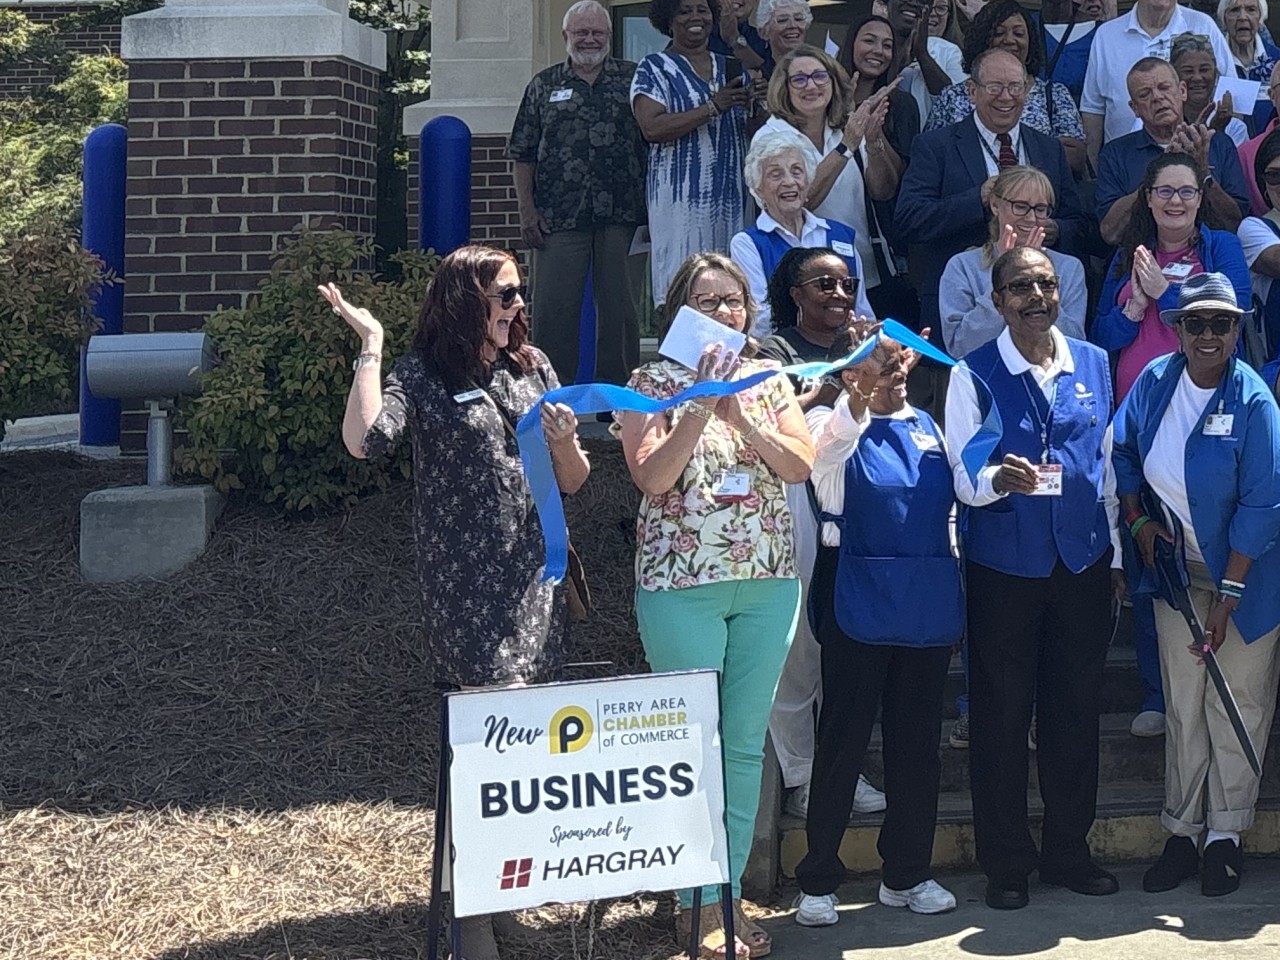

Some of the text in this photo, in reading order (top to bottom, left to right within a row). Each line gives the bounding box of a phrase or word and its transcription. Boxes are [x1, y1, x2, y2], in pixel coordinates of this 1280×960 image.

[603, 697, 687, 716] PERRY AREA
[603, 711, 688, 732] CHAMBER
[484, 714, 544, 753] New
[602, 727, 690, 748] of COMMERCE
[480, 761, 695, 819] BUSINESS
[549, 816, 634, 848] Sponsored by
[541, 843, 686, 881] HARGRAY
